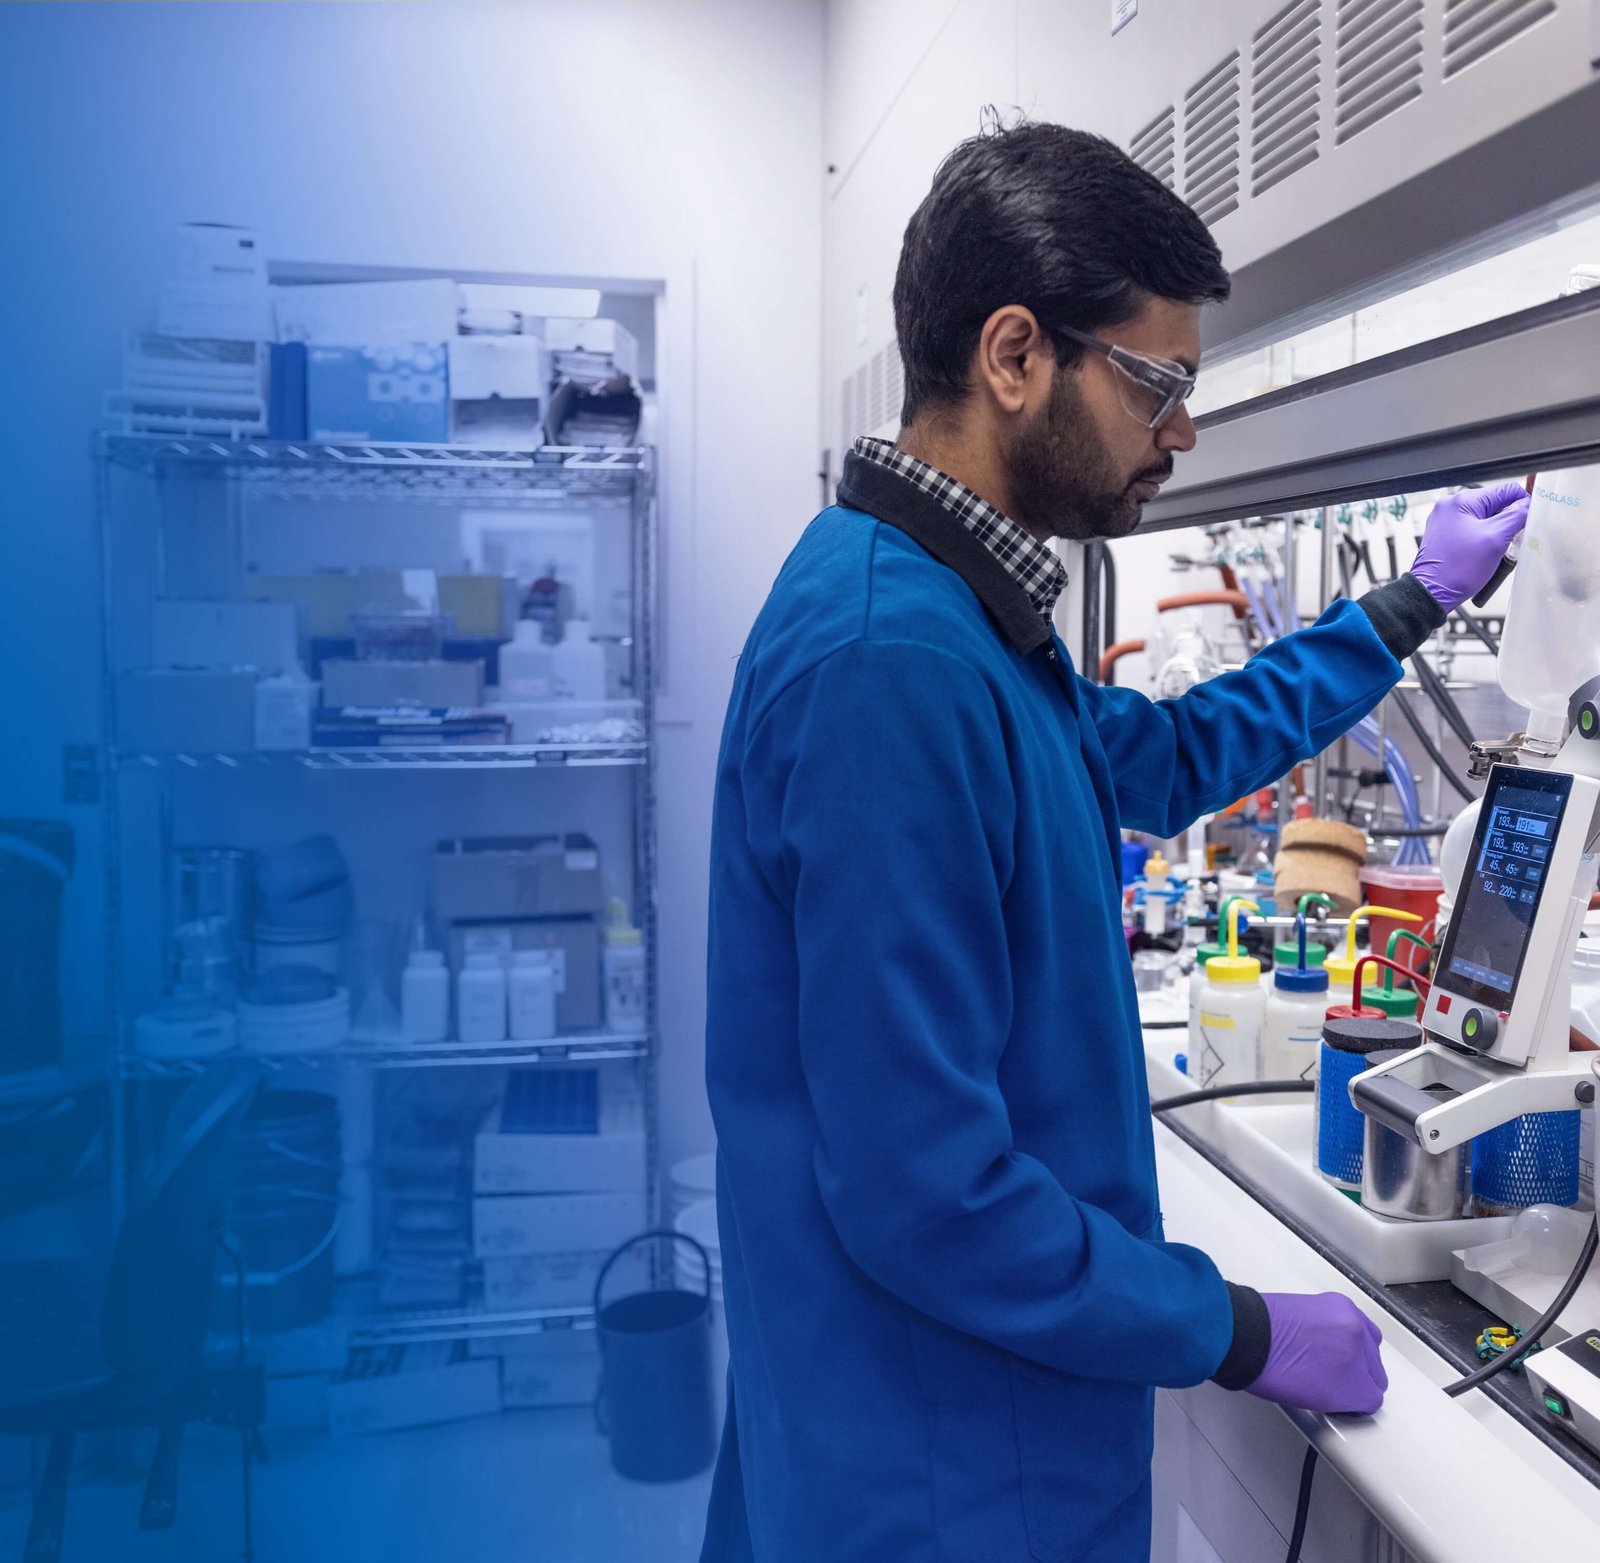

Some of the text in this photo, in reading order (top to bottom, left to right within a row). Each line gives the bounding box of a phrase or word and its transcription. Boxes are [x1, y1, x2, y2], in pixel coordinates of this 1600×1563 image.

[1499, 816, 1510, 827] 193
[1518, 819, 1529, 831] 191
[1493, 837, 1504, 849] 193
[1512, 841, 1524, 853] 193
[1489, 860, 1499, 871] 45
[1505, 863, 1515, 874] 45
[1483, 880, 1493, 892] 92
[1499, 885, 1512, 897] 220
